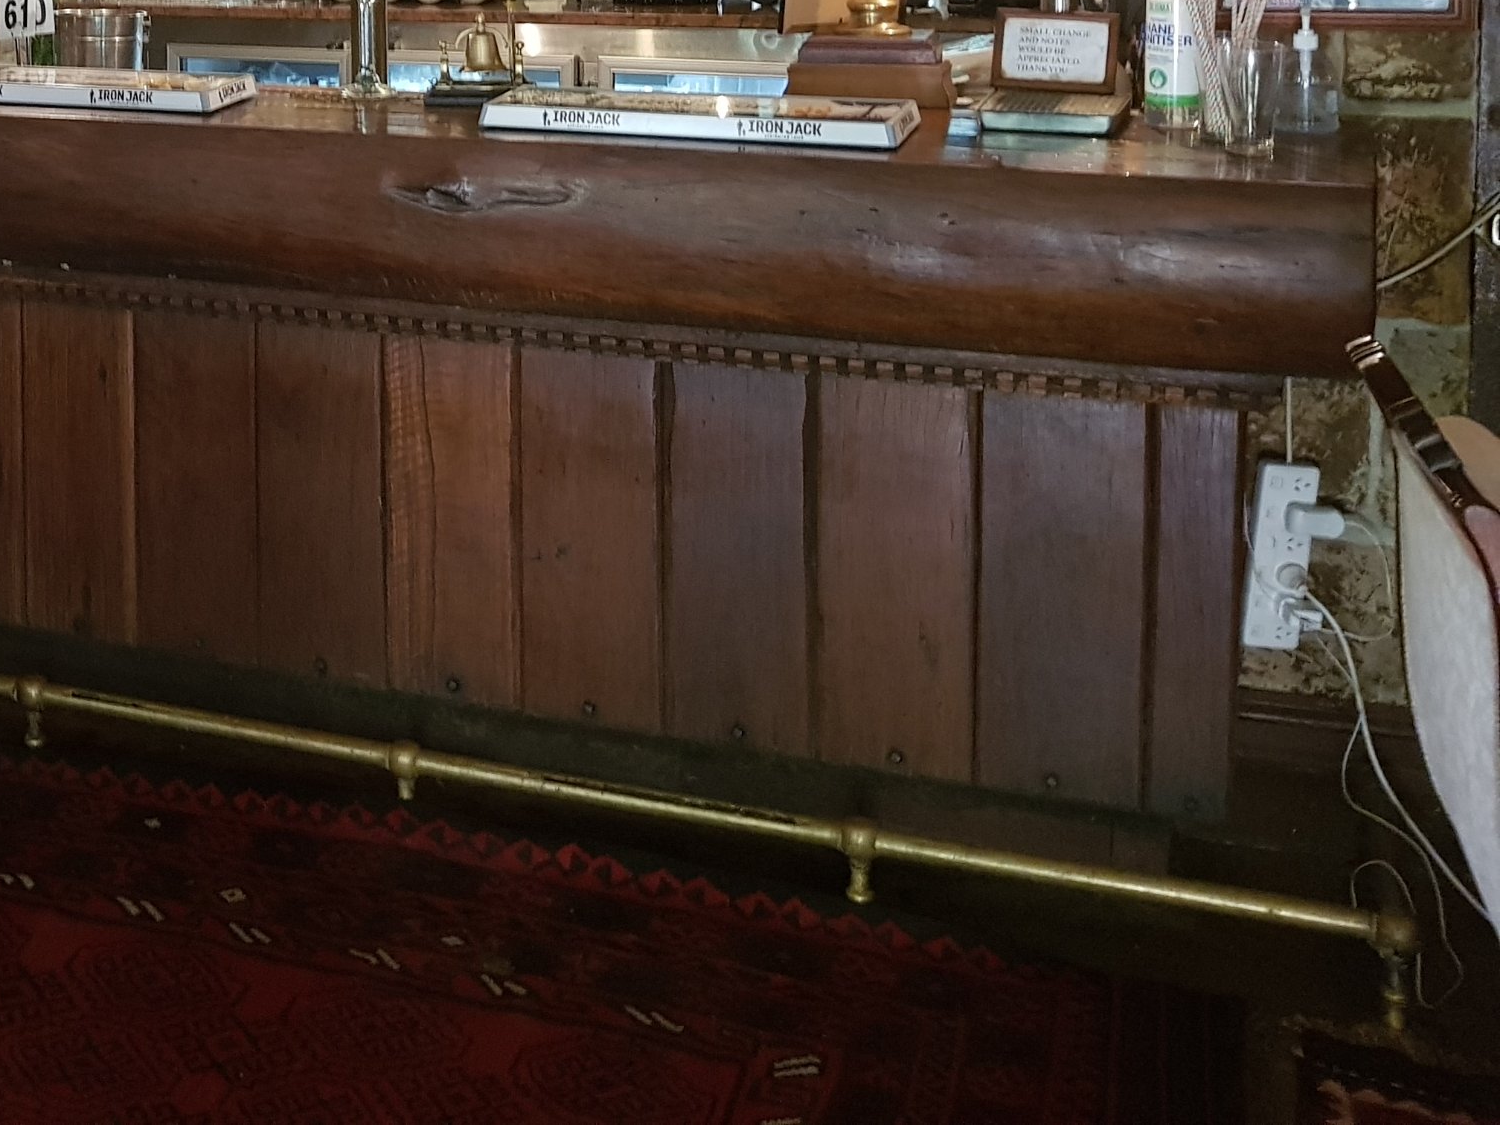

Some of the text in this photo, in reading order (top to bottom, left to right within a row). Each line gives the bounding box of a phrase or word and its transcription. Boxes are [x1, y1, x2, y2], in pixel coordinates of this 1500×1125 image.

[1020, 26, 1091, 38] SMALL CHANGE
[1019, 36, 1071, 46] AND NOTES
[1018, 44, 1066, 55] WOULD BE
[1016, 63, 1048, 72] THANK
[98, 88, 153, 104] IRON JACK
[553, 110, 620, 127] IRON JACK
[748, 119, 822, 137] IRON JACK
